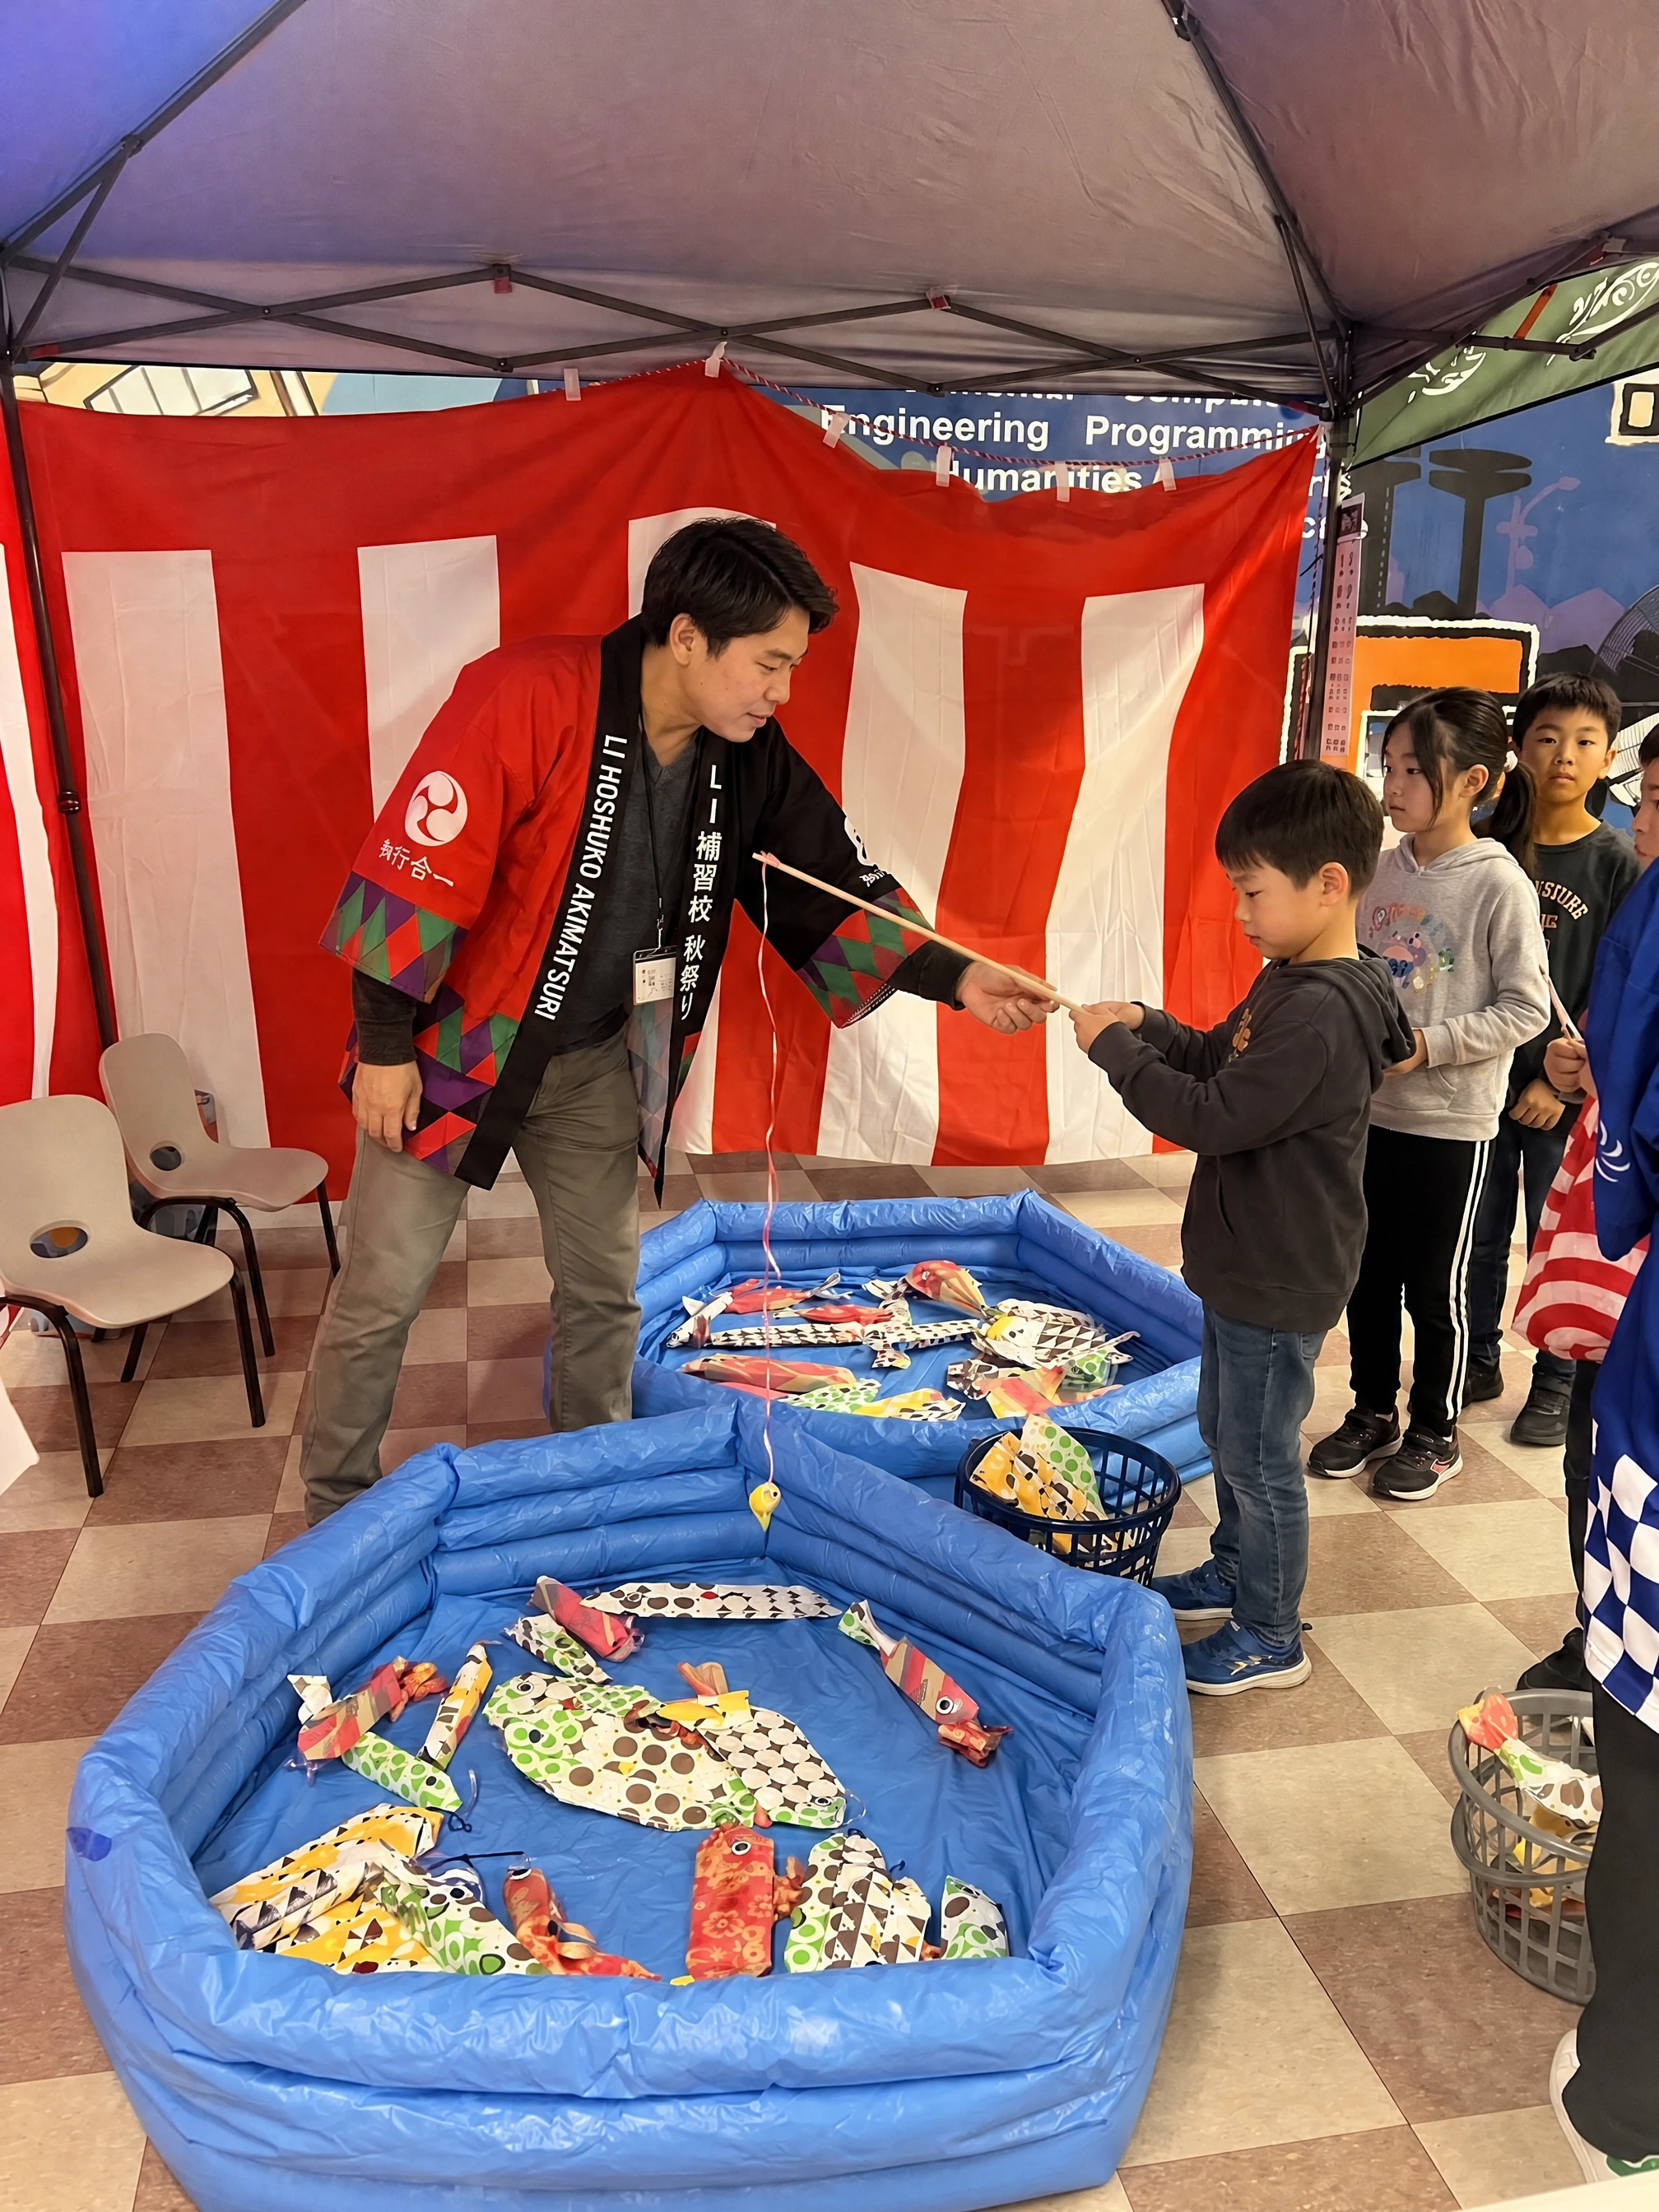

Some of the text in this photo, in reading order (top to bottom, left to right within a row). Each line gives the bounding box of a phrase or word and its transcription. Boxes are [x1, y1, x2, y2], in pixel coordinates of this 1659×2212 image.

[820, 404, 1049, 452] Engineering
[534, 734, 628, 1020] LI HOSHUKO AKIMATSURI
[680, 934, 706, 1020] 秋祭り
